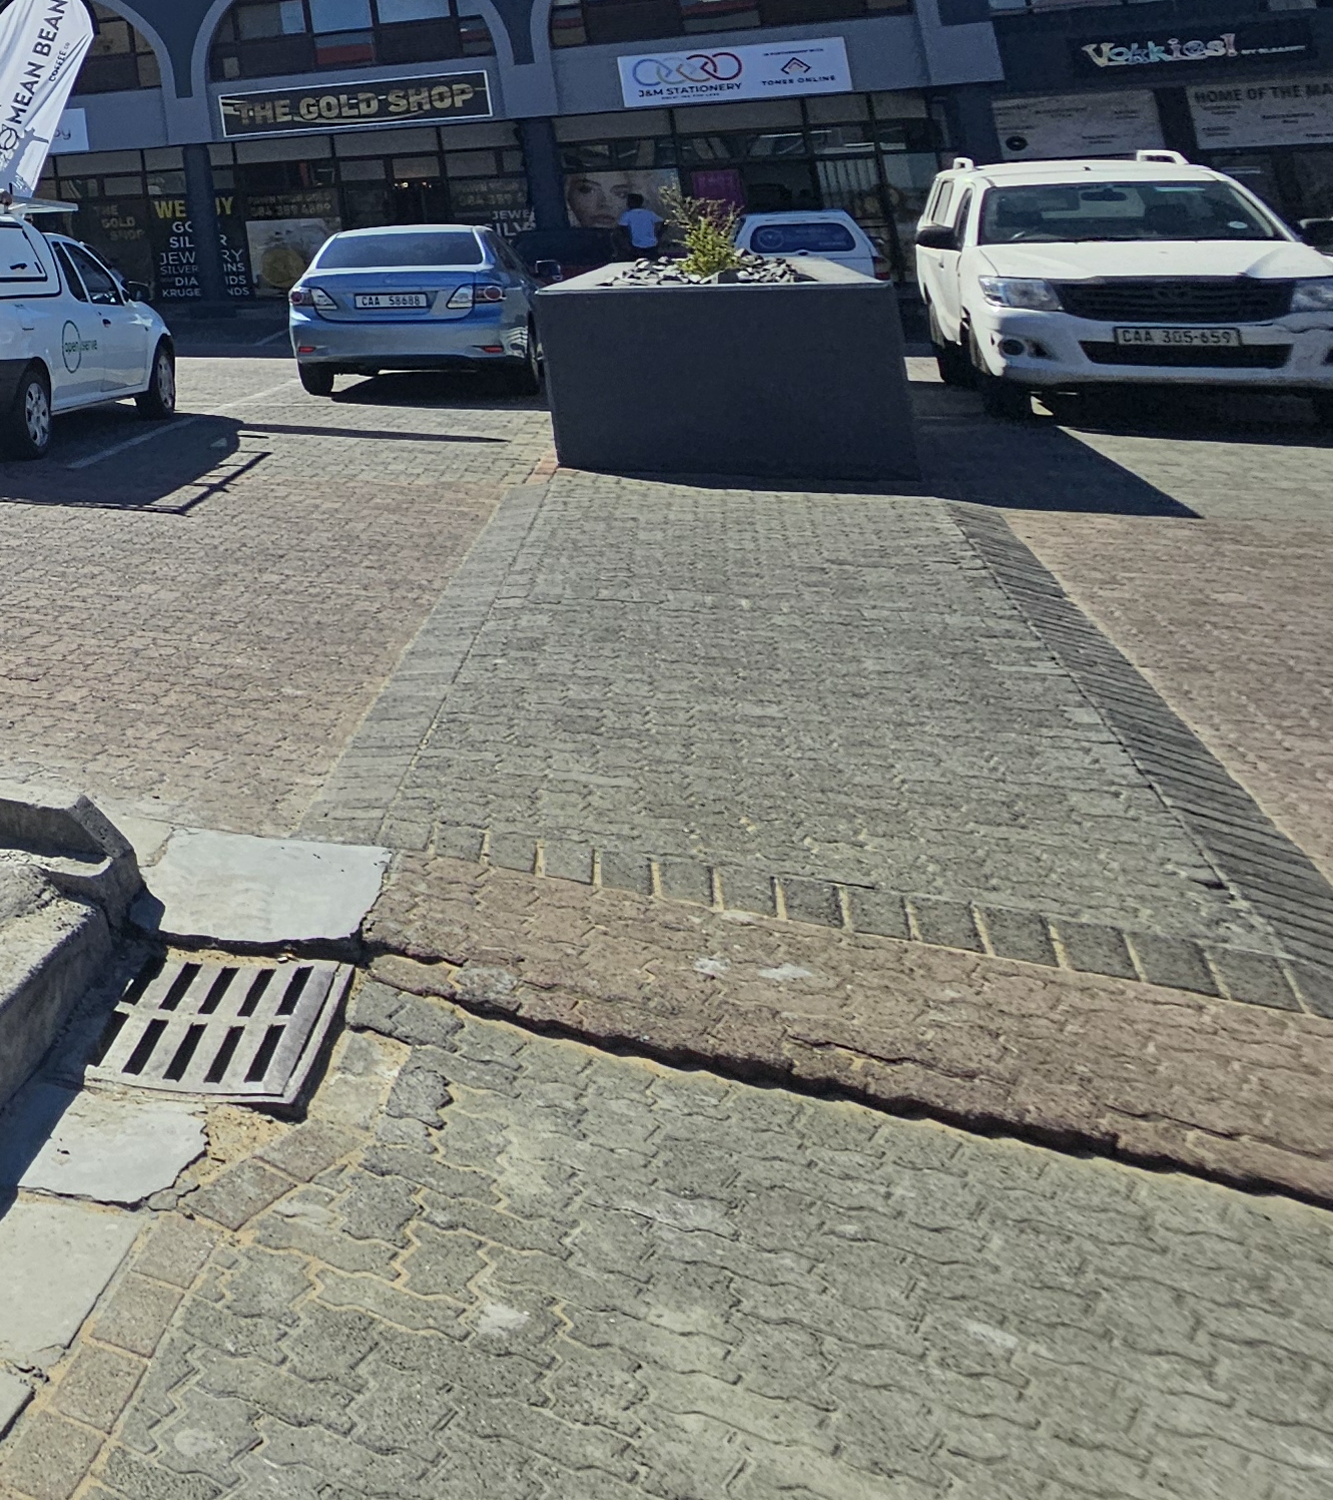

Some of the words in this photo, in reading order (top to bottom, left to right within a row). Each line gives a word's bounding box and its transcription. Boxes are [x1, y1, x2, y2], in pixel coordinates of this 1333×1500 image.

[48, 50, 66, 82] COFFEE
[5, 61, 46, 125] MEAN
[638, 88, 664, 98] J&M
[665, 82, 743, 95] STATIONERY
[1194, 87, 1243, 103] HOME
[1247, 86, 1266, 100] OF
[1267, 84, 1302, 99] THE
[235, 100, 293, 125] THE
[299, 91, 380, 121] GOLD
[387, 83, 475, 113] SHOP
[361, 296, 381, 307] CAA
[1122, 329, 1155, 343] CAA
[1162, 330, 1232, 344] 305-659
